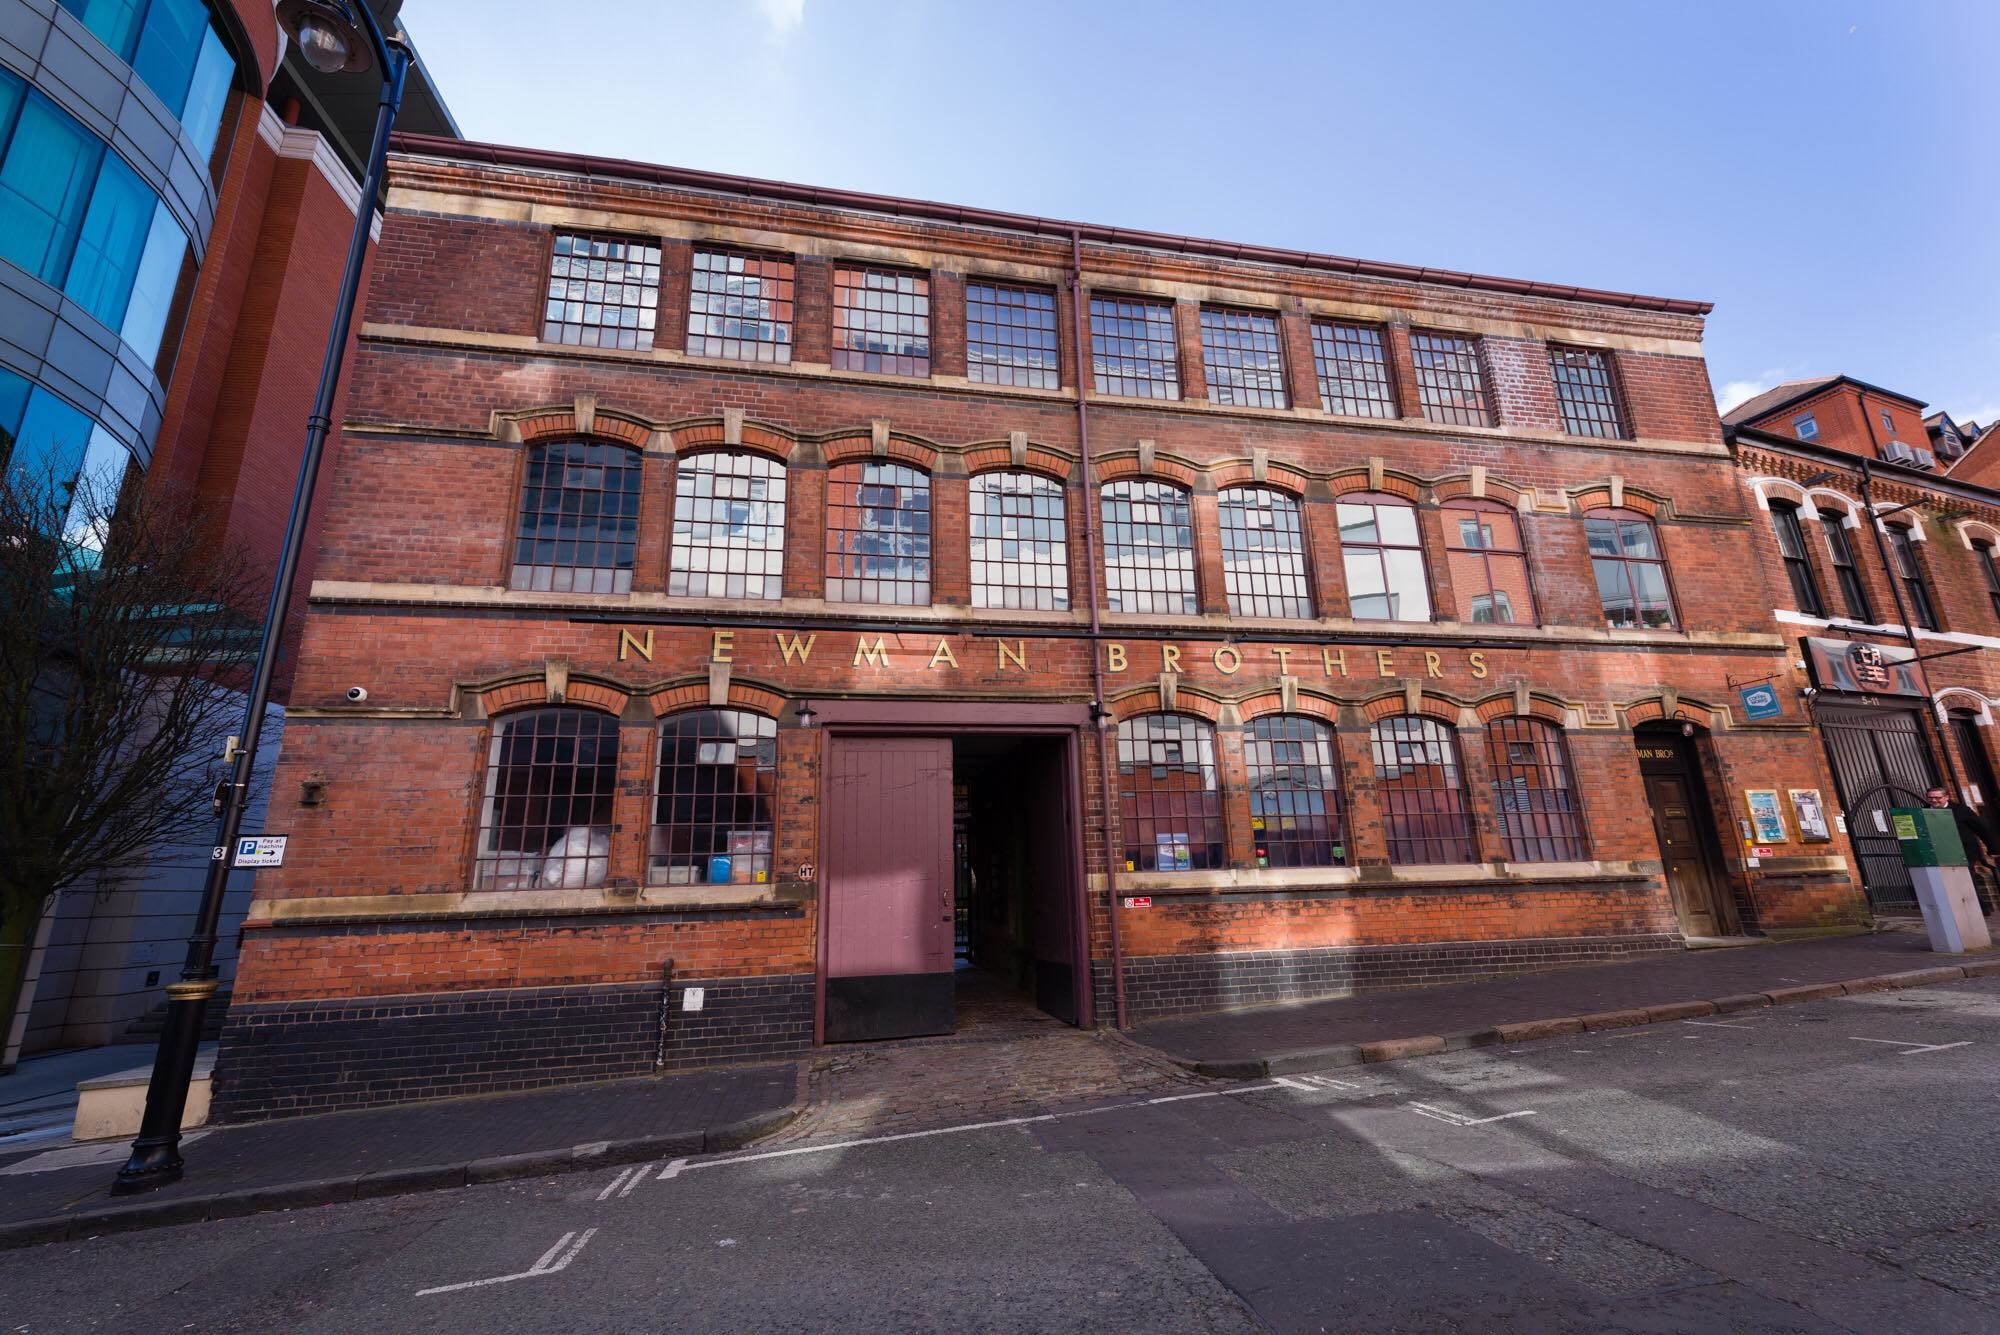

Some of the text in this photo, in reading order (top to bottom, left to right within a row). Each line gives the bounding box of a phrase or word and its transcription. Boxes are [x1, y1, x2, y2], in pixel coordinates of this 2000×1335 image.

[618, 628, 1488, 678] NEWMAN BROTHERS
[1861, 696, 1880, 706] 5-11
[213, 847, 223, 859] 3
[243, 842, 254, 853] P
[800, 867, 813, 876] HT
